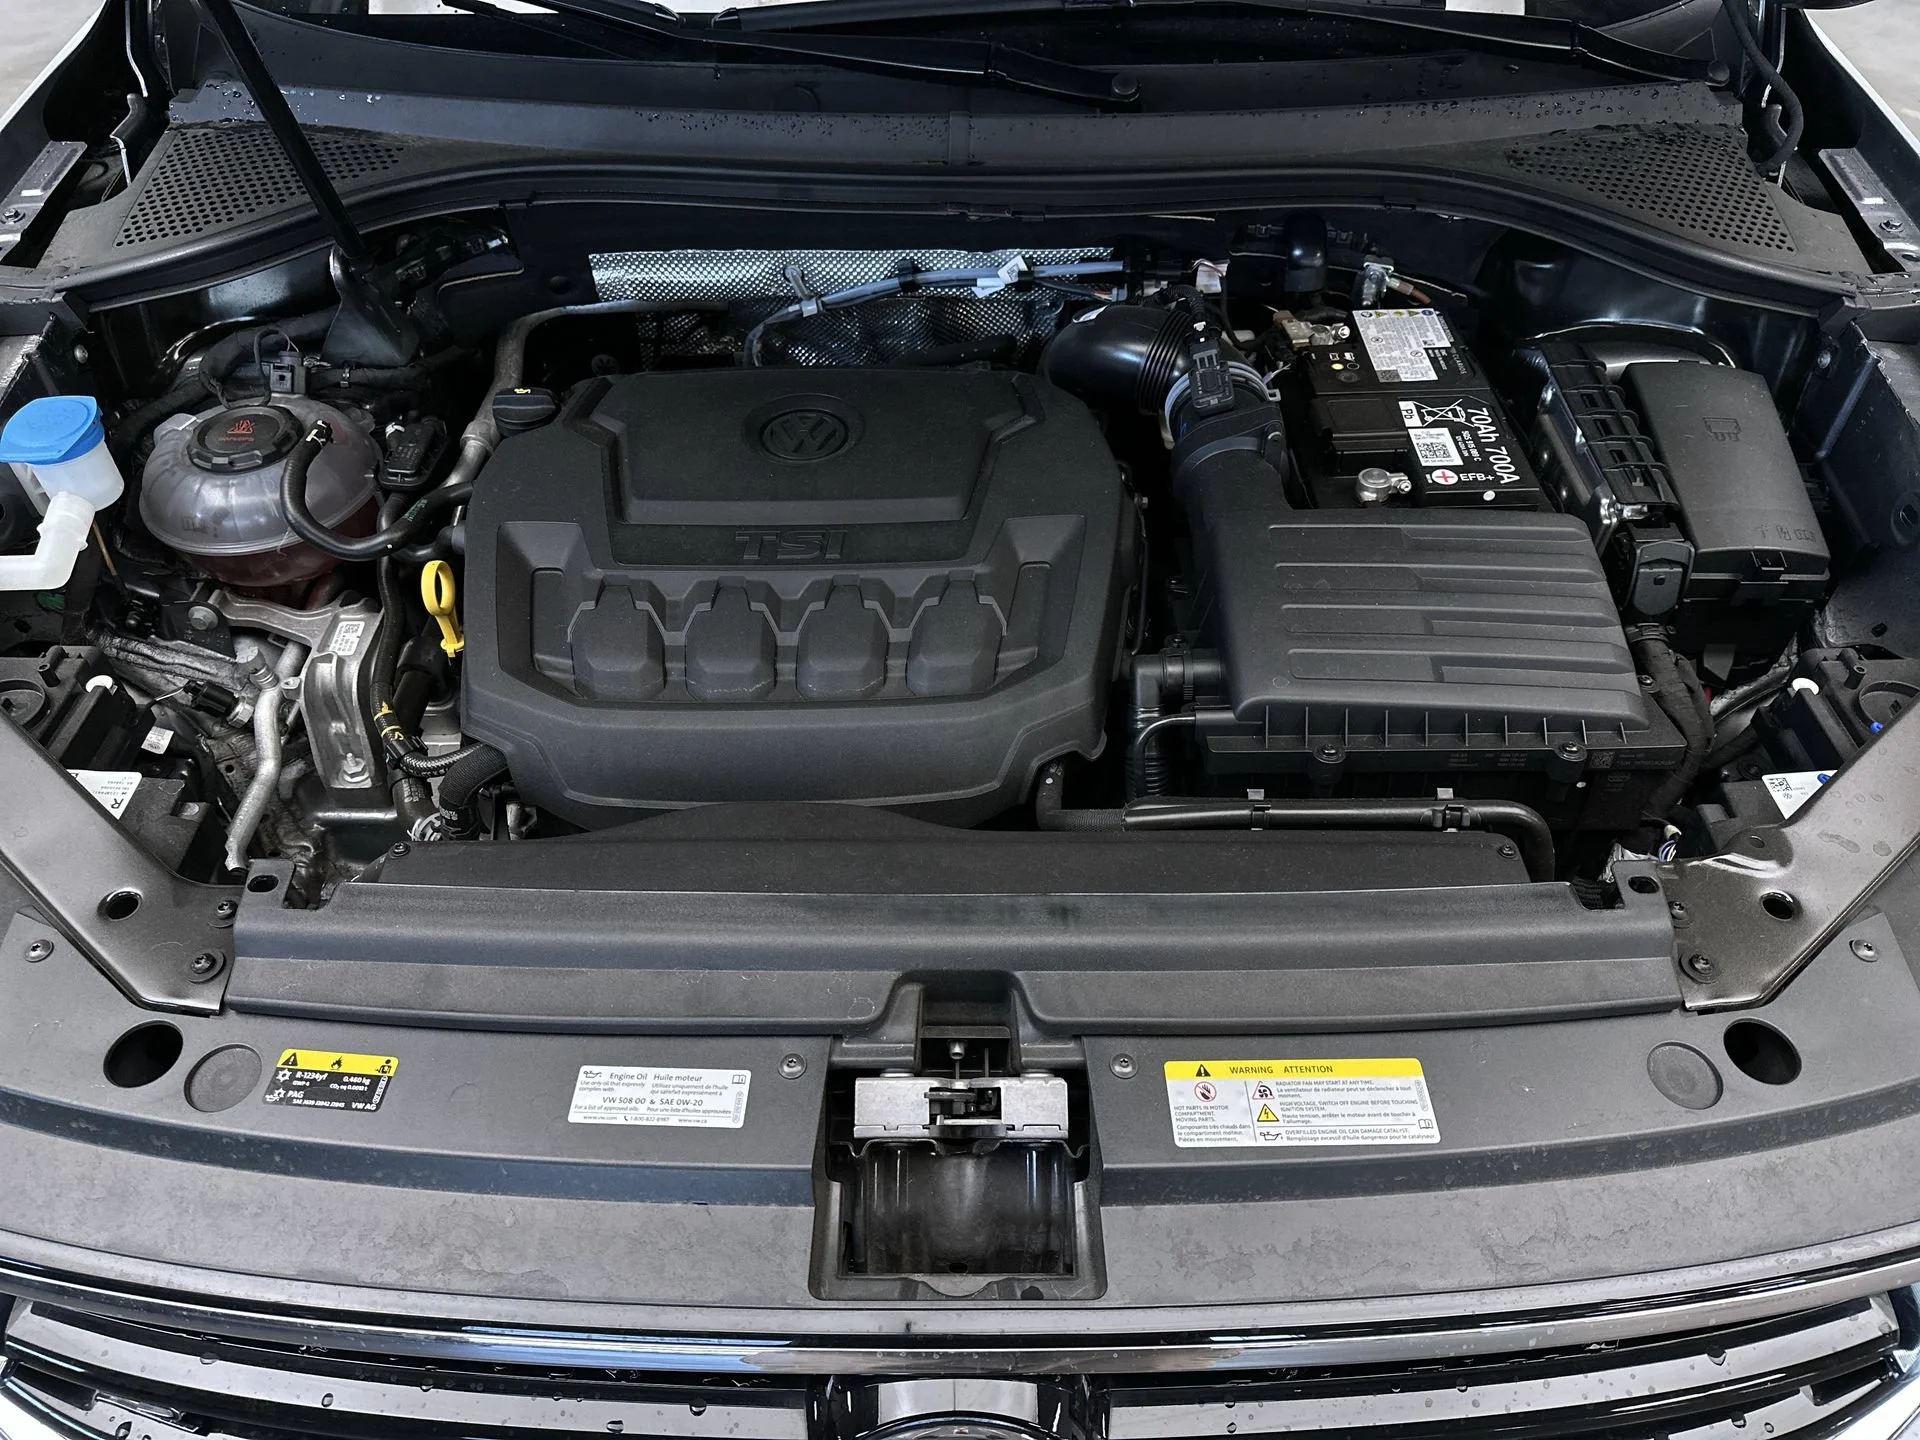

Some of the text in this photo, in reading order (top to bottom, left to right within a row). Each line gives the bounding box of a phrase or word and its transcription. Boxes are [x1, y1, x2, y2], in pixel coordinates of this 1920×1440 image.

[1401, 408, 1416, 420] Pb
[760, 409, 848, 461] VW
[1467, 408, 1520, 484] 70Ah 700A
[1460, 473, 1494, 481] EFB+
[736, 530, 848, 559] TSI
[1284, 1065, 1333, 1073] ATTENTION
[296, 1072, 328, 1082] R-1234yf
[610, 1073, 635, 1081] Engine
